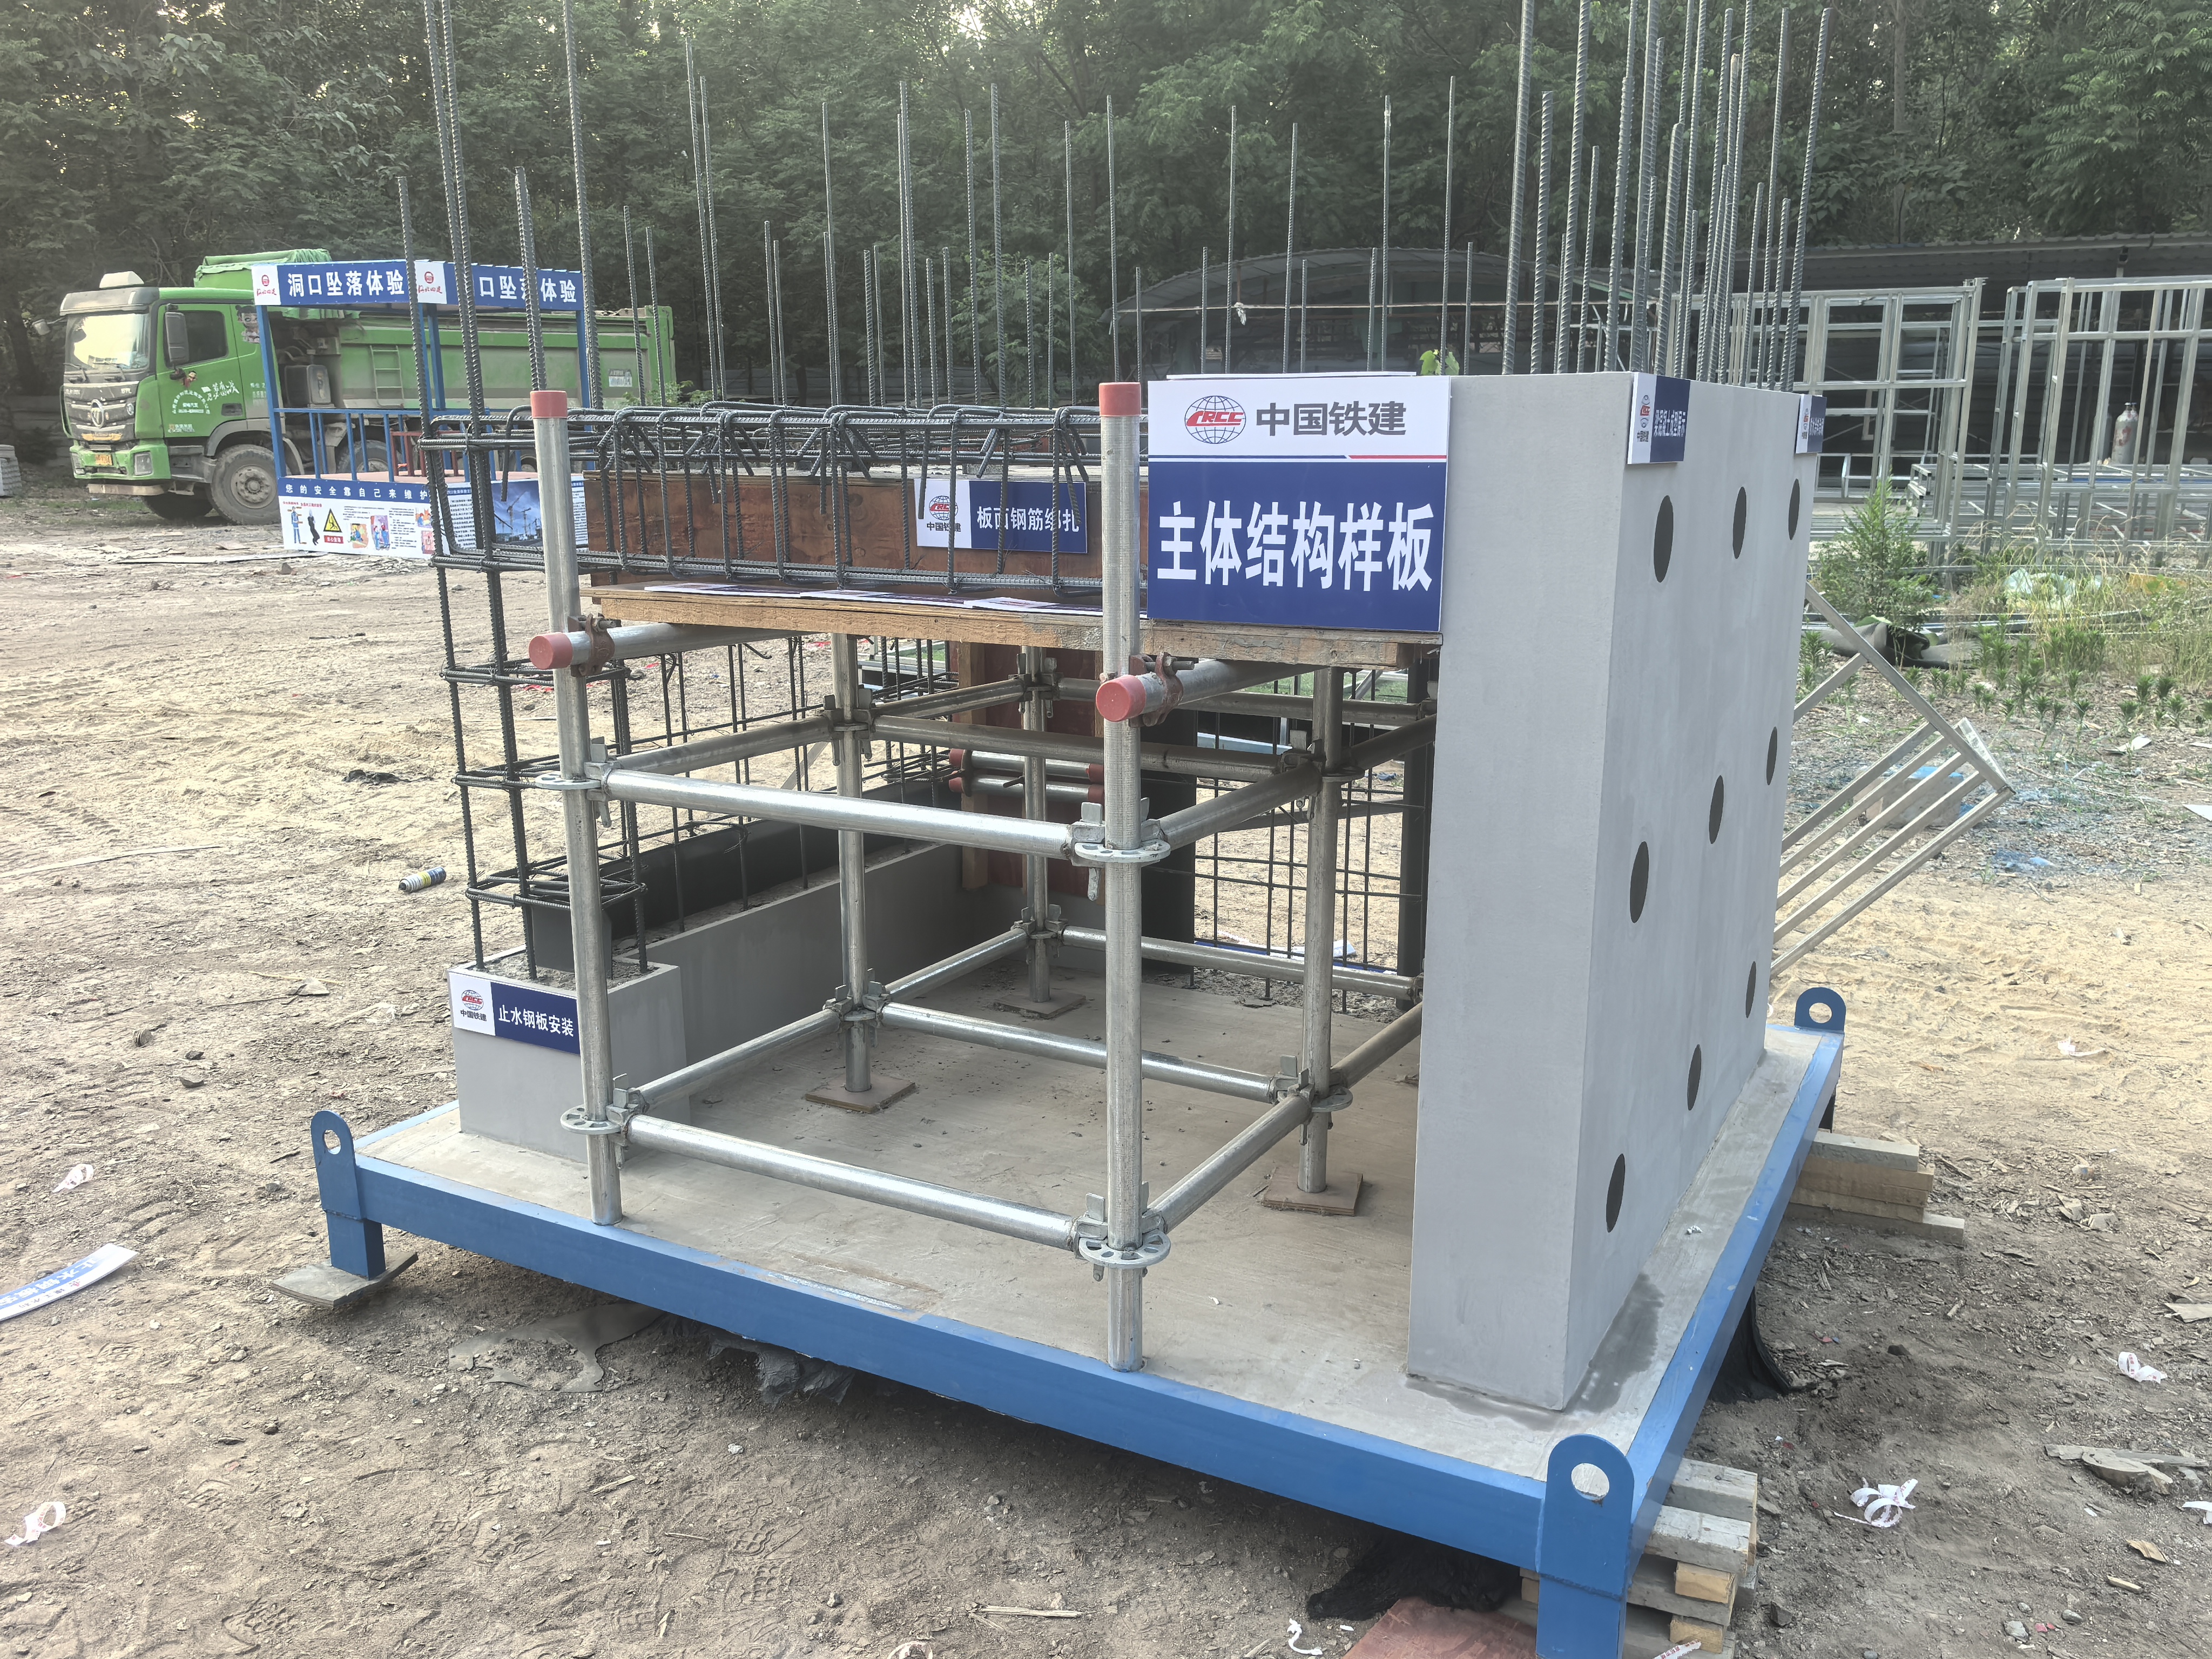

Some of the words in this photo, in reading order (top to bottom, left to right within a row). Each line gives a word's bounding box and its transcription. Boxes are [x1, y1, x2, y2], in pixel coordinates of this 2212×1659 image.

[287, 269, 404, 297] 洞口坠落体验
[460, 273, 577, 302] 口坠体验
[1186, 410, 1246, 427] CRCC
[1256, 401, 1407, 437] 中国铁建
[286, 484, 428, 500] 您的安全靠自己来维护
[1157, 500, 1434, 592] 主体结构样板
[460, 1009, 487, 1022] 中国铁建
[498, 1004, 575, 1037] 止水钢板安装
